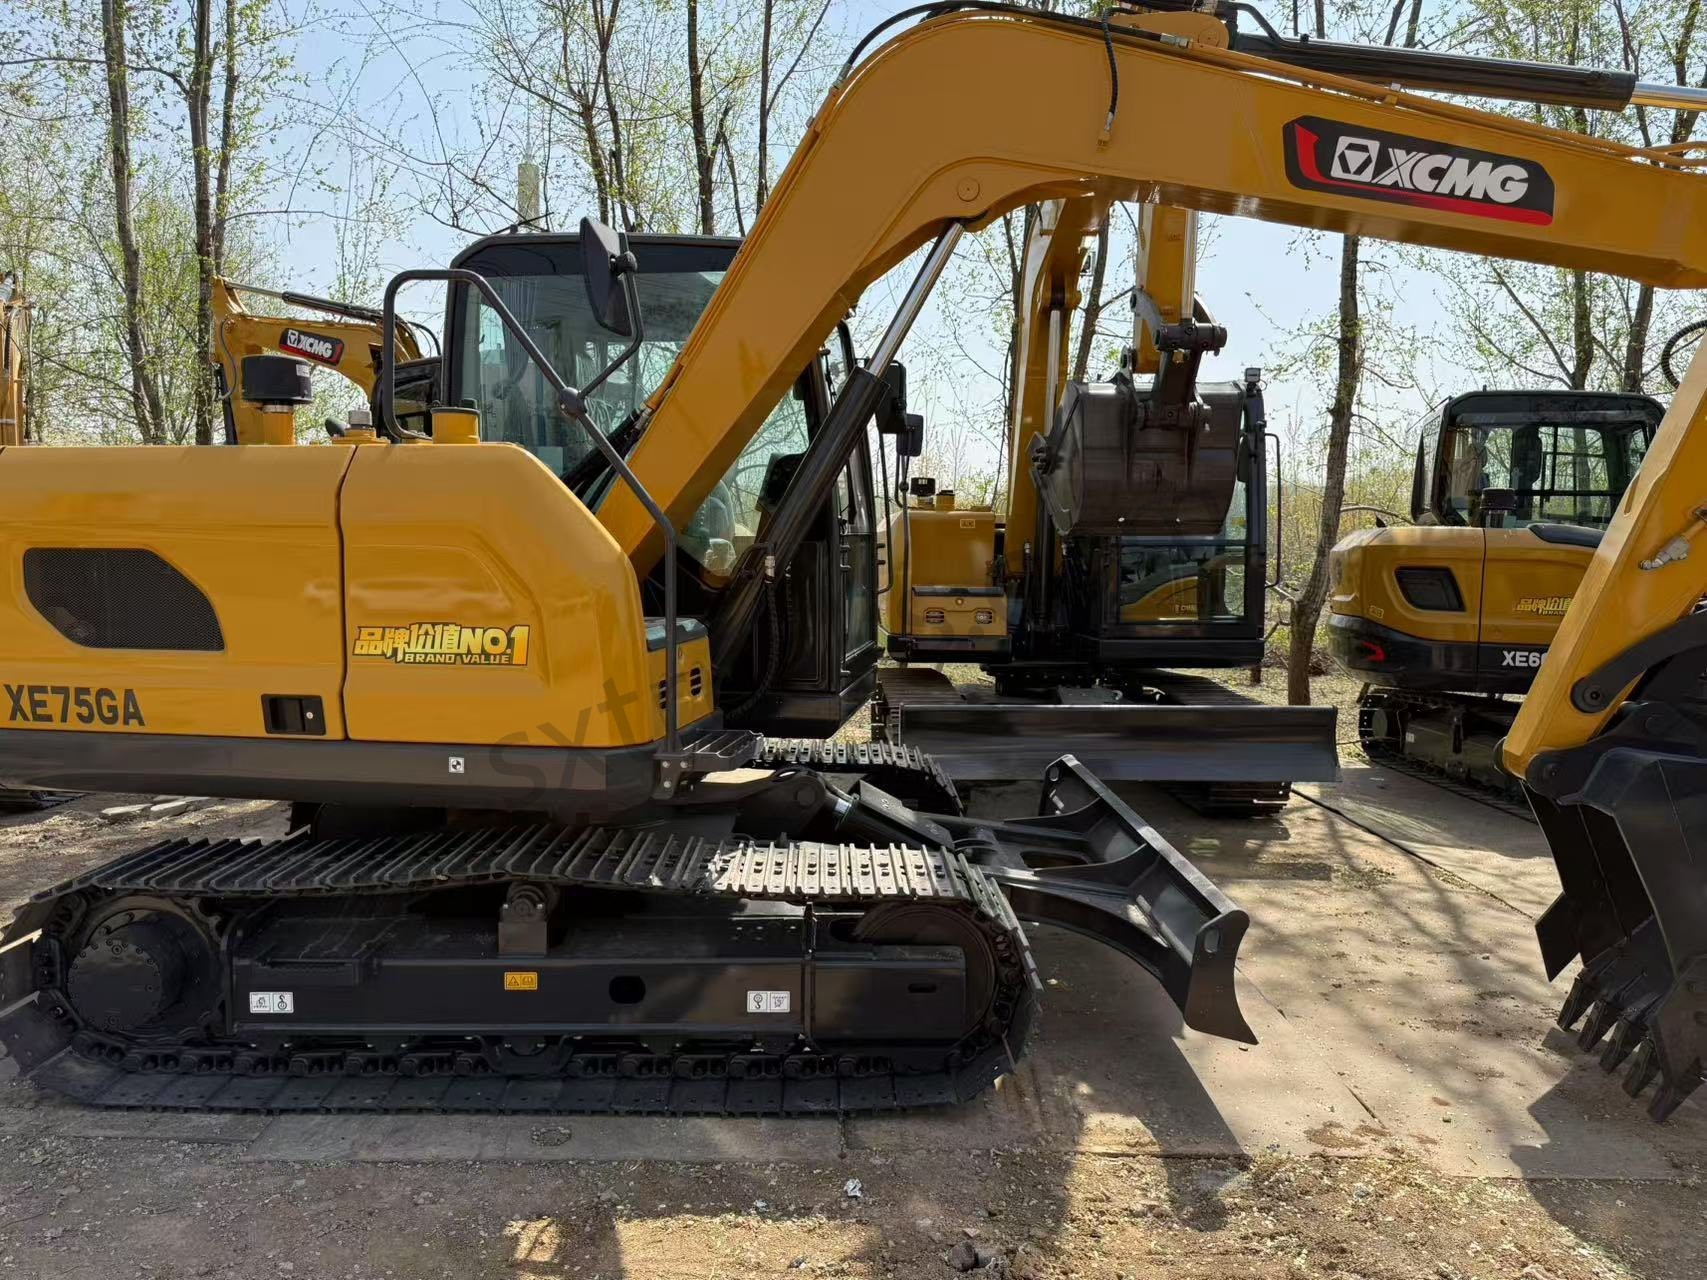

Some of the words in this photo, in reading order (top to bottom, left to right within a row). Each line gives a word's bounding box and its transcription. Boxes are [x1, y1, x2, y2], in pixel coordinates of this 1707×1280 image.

[1372, 147, 1529, 204] XCMG
[296, 334, 332, 358] XCMG
[404, 653, 455, 664] BRAND
[462, 653, 510, 665] VALUE
[2, 683, 146, 727] XE75GA
